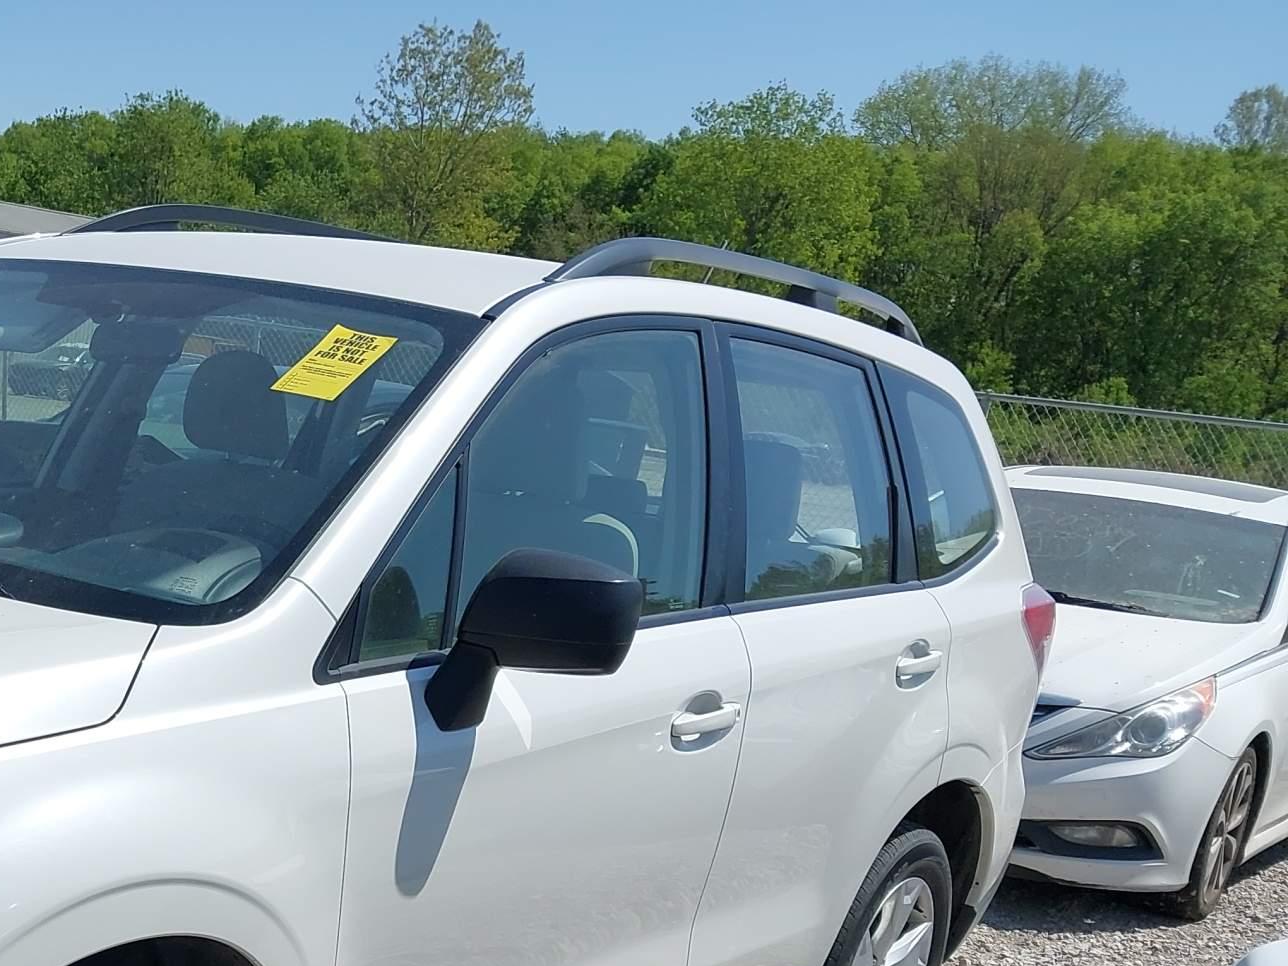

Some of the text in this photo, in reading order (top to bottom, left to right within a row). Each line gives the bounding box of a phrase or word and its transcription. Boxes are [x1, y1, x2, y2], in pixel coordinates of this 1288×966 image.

[350, 333, 377, 343] THIS
[333, 337, 380, 352] VEHICLE
[314, 350, 338, 360] FOR
[338, 355, 368, 366] SALE
[342, 348, 369, 356] NOT
